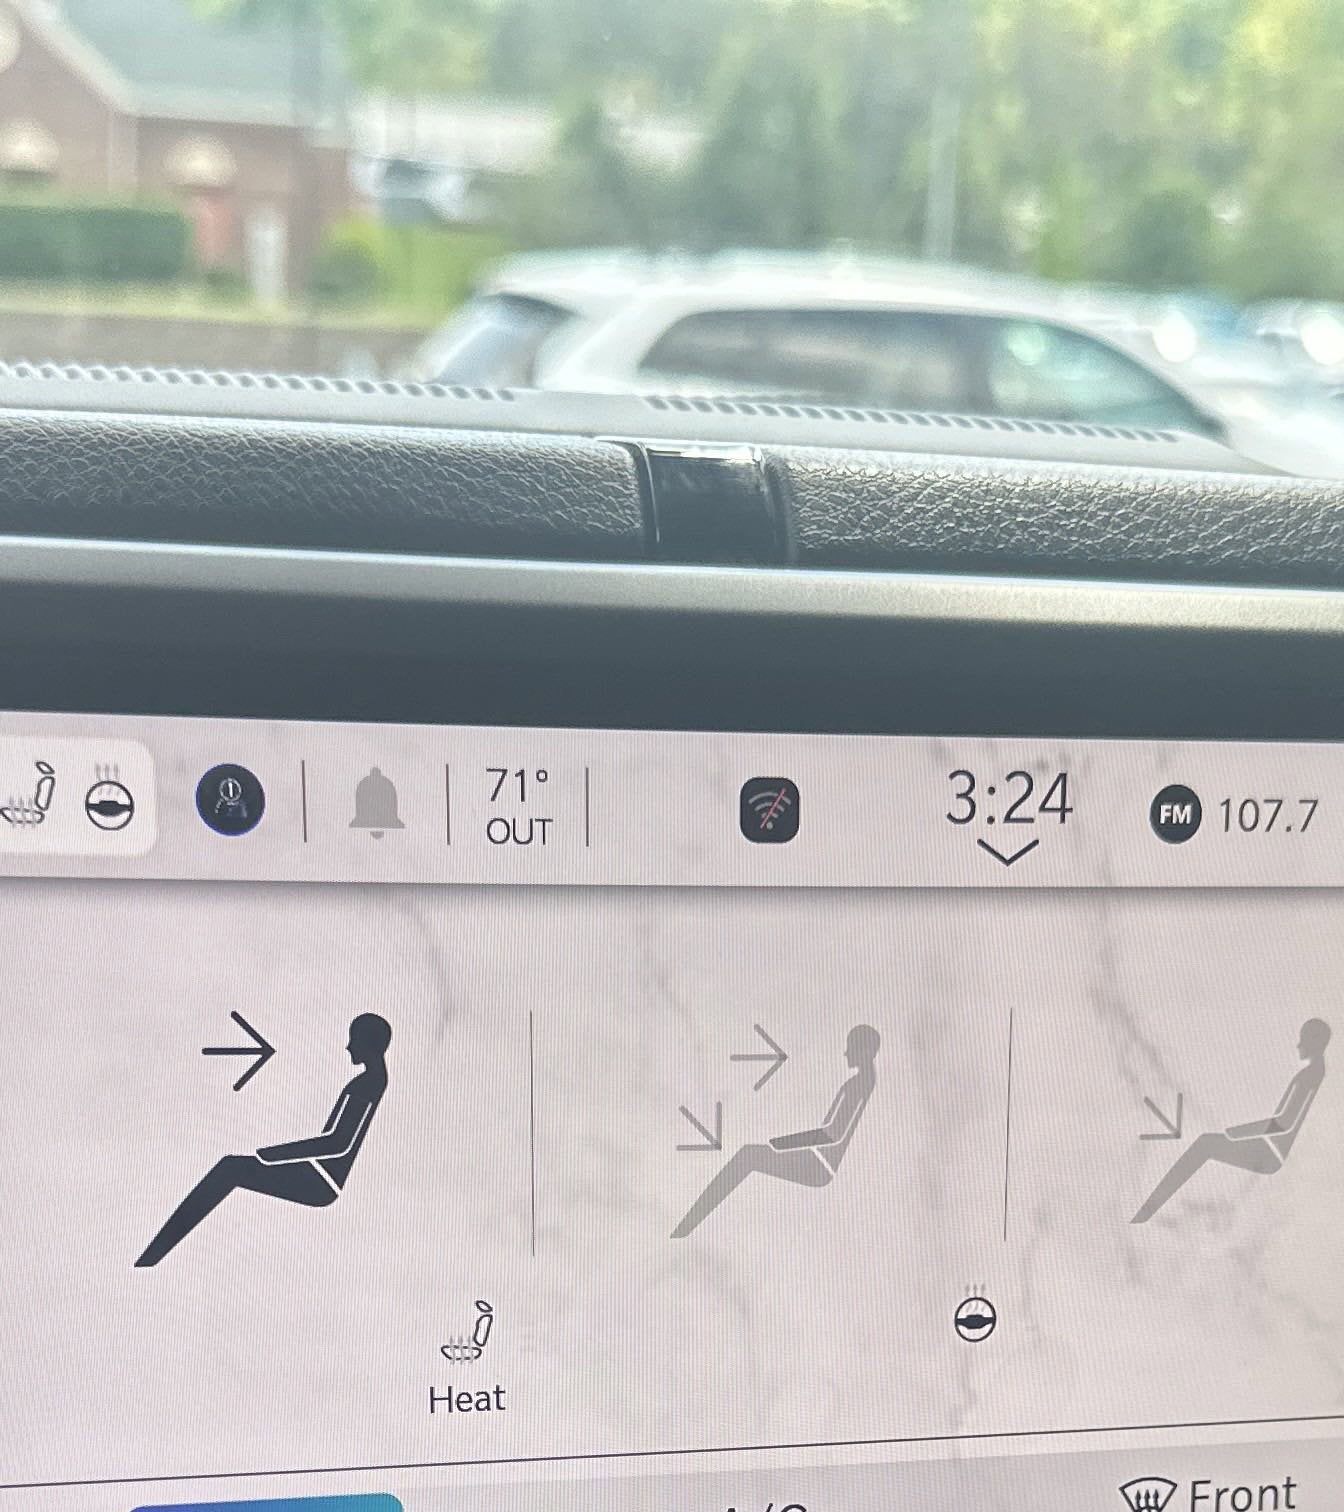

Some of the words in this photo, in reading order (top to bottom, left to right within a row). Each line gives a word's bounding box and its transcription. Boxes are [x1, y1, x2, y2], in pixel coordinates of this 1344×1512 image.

[485, 767, 550, 803] 71°
[946, 768, 1074, 826] 3:24
[486, 816, 554, 847] OUT
[1159, 802, 1193, 825] FM
[1219, 797, 1319, 834] 107.7
[428, 1382, 506, 1414] Heat
